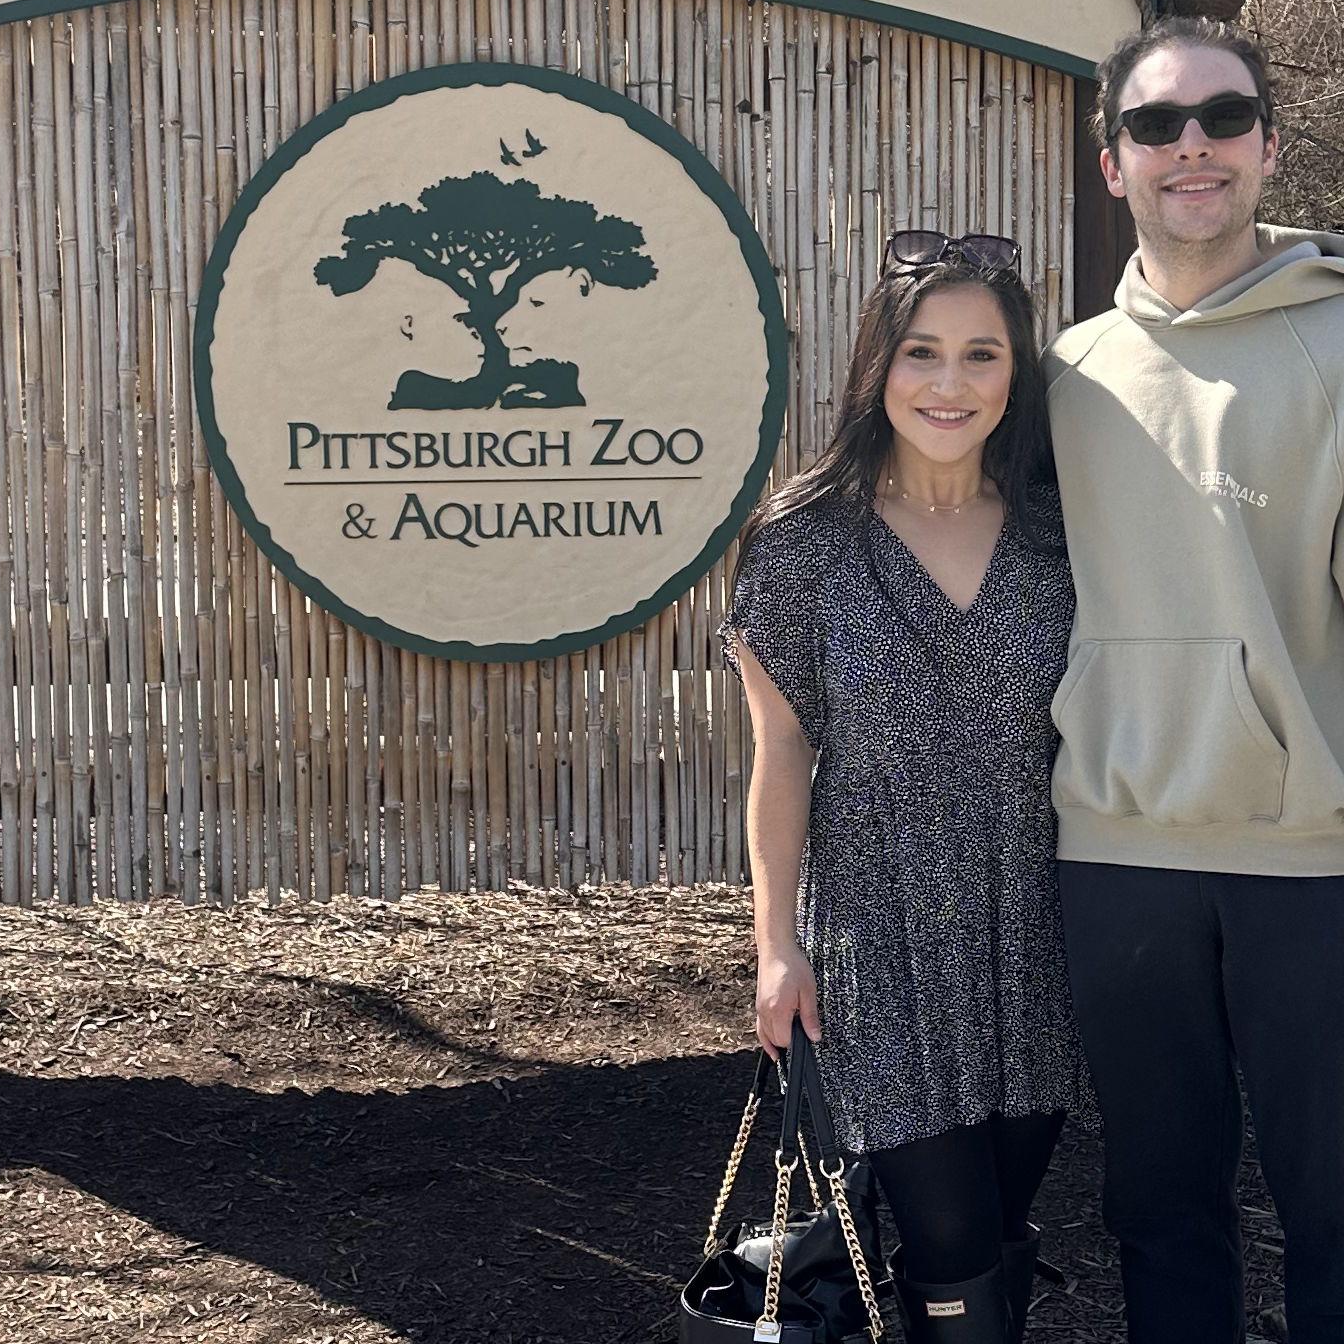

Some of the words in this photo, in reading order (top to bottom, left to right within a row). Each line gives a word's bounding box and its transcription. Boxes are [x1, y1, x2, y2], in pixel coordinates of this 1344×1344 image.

[286, 421, 572, 470] PITTSBURGH
[589, 418, 704, 466] ZOO
[1200, 471, 1269, 508] ESENIALS
[341, 502, 379, 540] &
[389, 492, 663, 548] AQUARIUM
